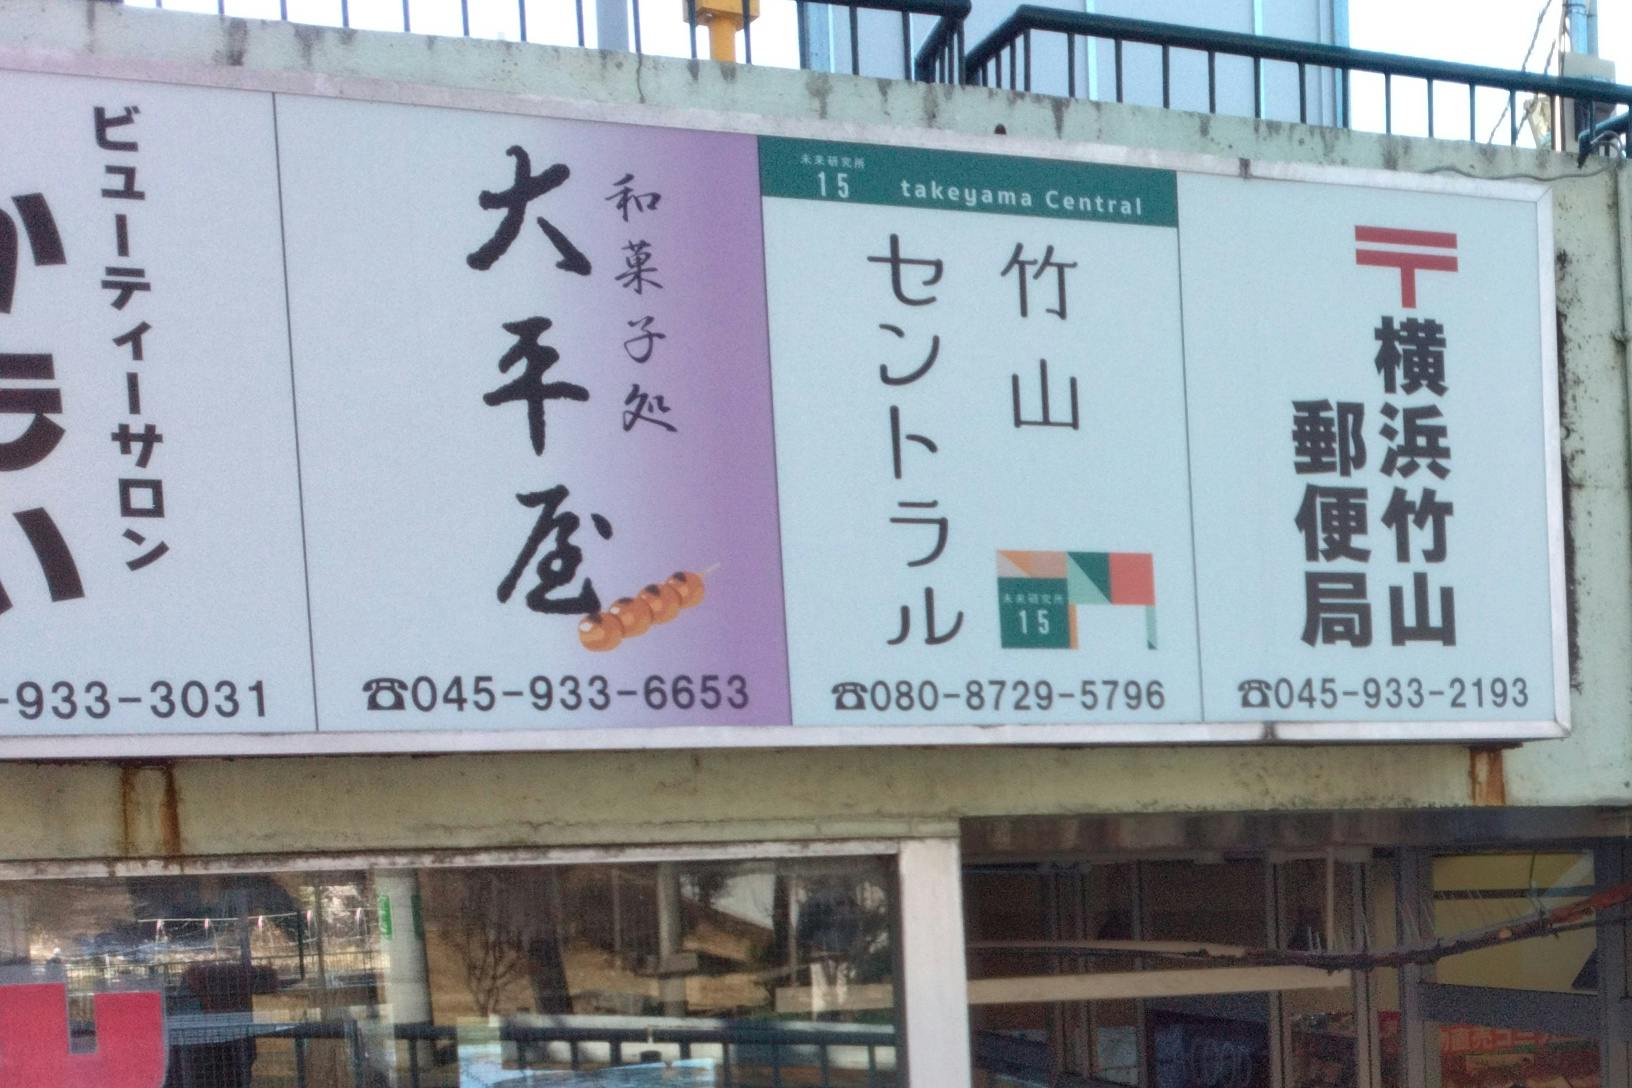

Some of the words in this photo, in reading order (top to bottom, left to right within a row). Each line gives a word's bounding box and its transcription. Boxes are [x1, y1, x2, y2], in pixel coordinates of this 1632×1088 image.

[815, 171, 850, 199] 15
[899, 179, 1032, 209] takeyama
[1044, 190, 1143, 217] Central
[93, 105, 170, 572] ビューティーサロン
[466, 145, 613, 616] 大平屋
[605, 173, 678, 433] 和菓子処
[1000, 242, 1080, 431] 竹山
[866, 232, 964, 646] セントラル
[1292, 399, 1372, 648] 郵便局
[1374, 315, 1458, 648] 横浜竹山
[411, 674, 750, 712] 045-933-6653
[870, 679, 1165, 713] 080-8729-5796
[1019, 609, 1049, 635] 15
[1274, 677, 1529, 710] 045-933-2193
